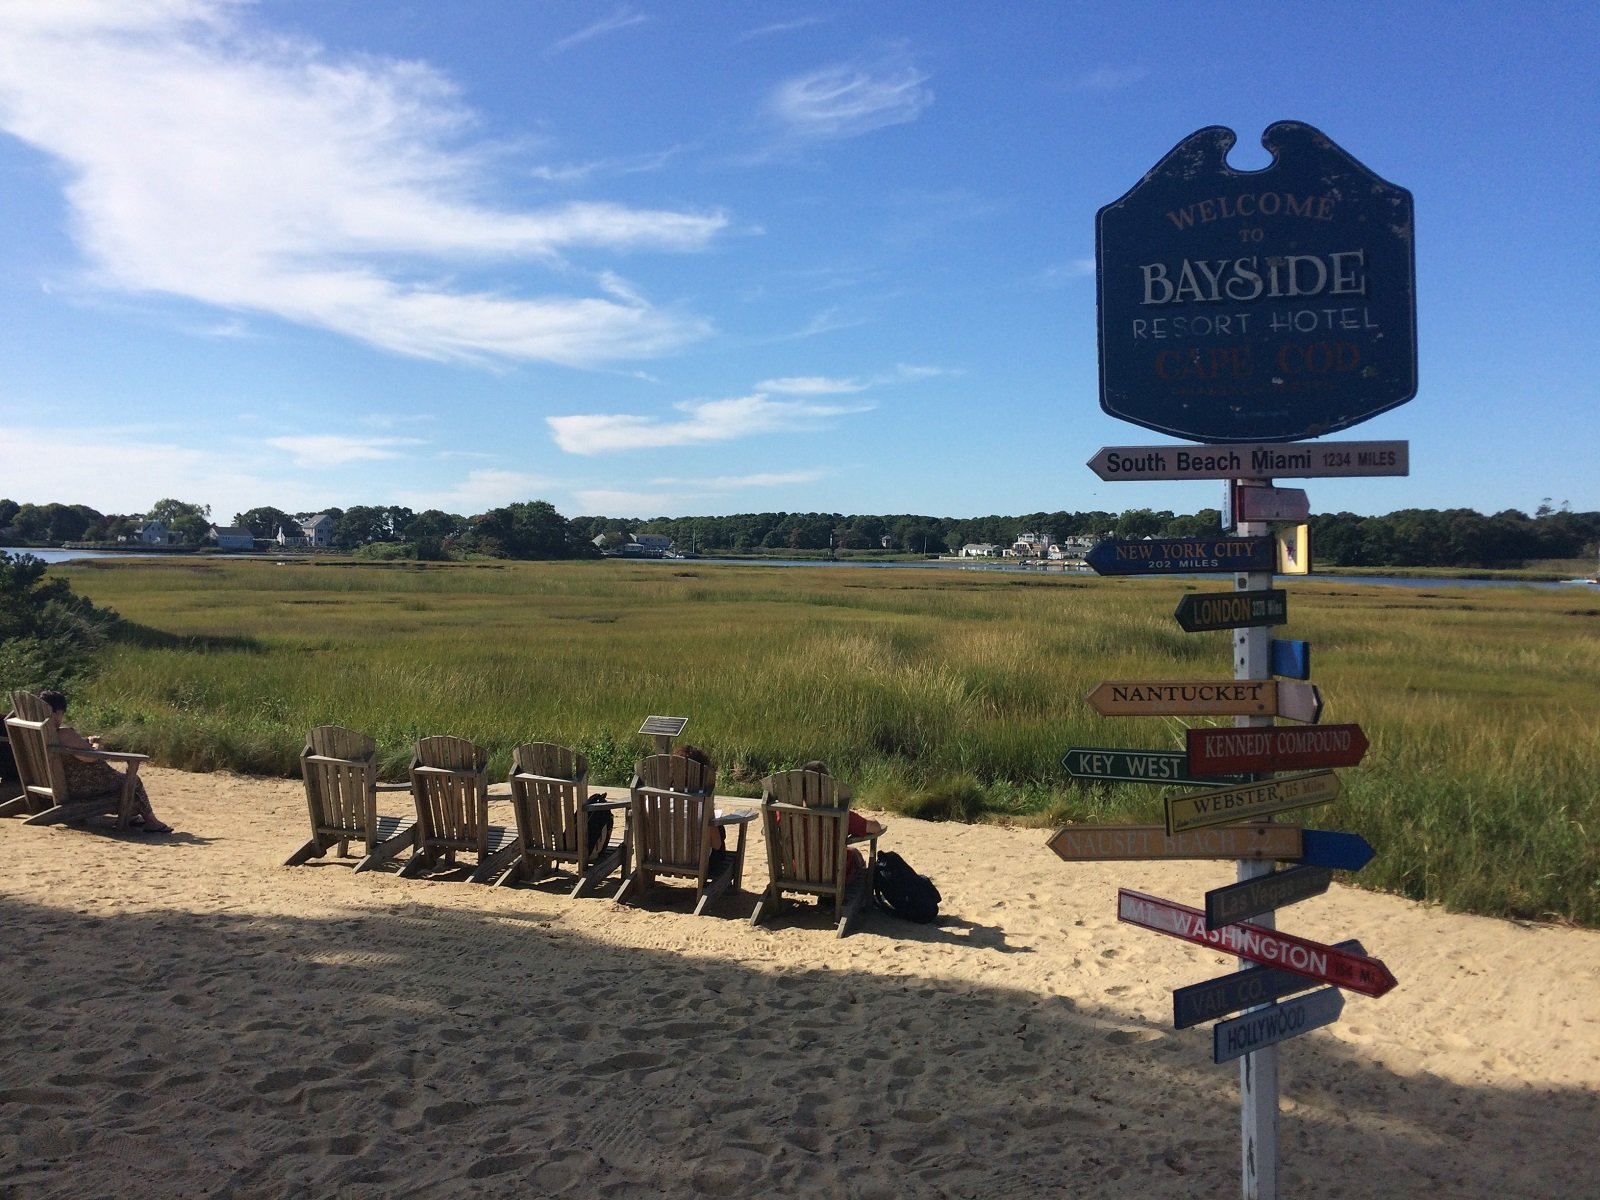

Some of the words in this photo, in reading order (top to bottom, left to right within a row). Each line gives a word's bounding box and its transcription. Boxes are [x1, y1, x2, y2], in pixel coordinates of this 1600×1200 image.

[1167, 192, 1335, 231] WELCOME
[1240, 228, 1264, 242] TO
[1139, 249, 1366, 305] BAYSIDE
[1133, 314, 1251, 339] RESORT
[1270, 307, 1379, 333] HOTEL
[1279, 341, 1361, 374] COD
[1107, 452, 1166, 473] South
[1177, 451, 1241, 472] Beach
[1252, 449, 1311, 470] Miami
[1322, 453, 1351, 467] 1234
[1358, 451, 1396, 466] MILES
[1115, 545, 1153, 560] NEW
[1161, 543, 1206, 559] YORK
[1214, 542, 1256, 558] CITY
[1149, 560, 1172, 569] 202
[1179, 558, 1219, 568] MILES
[1194, 598, 1250, 625] LONDON
[1112, 686, 1263, 702] NANTUCKET
[1205, 734, 1273, 758] KENNEDY
[1277, 730, 1351, 753] COMPOUND
[1079, 754, 1114, 775] KEY
[1126, 756, 1181, 779] WEST
[1193, 786, 1279, 814] WEBSTER
[1066, 832, 1151, 856] NAUSET
[1163, 830, 1236, 855] BEACH
[1172, 912, 1327, 976] WASHINGTON
[1228, 1006, 1306, 1052] HOLLYWOOD
